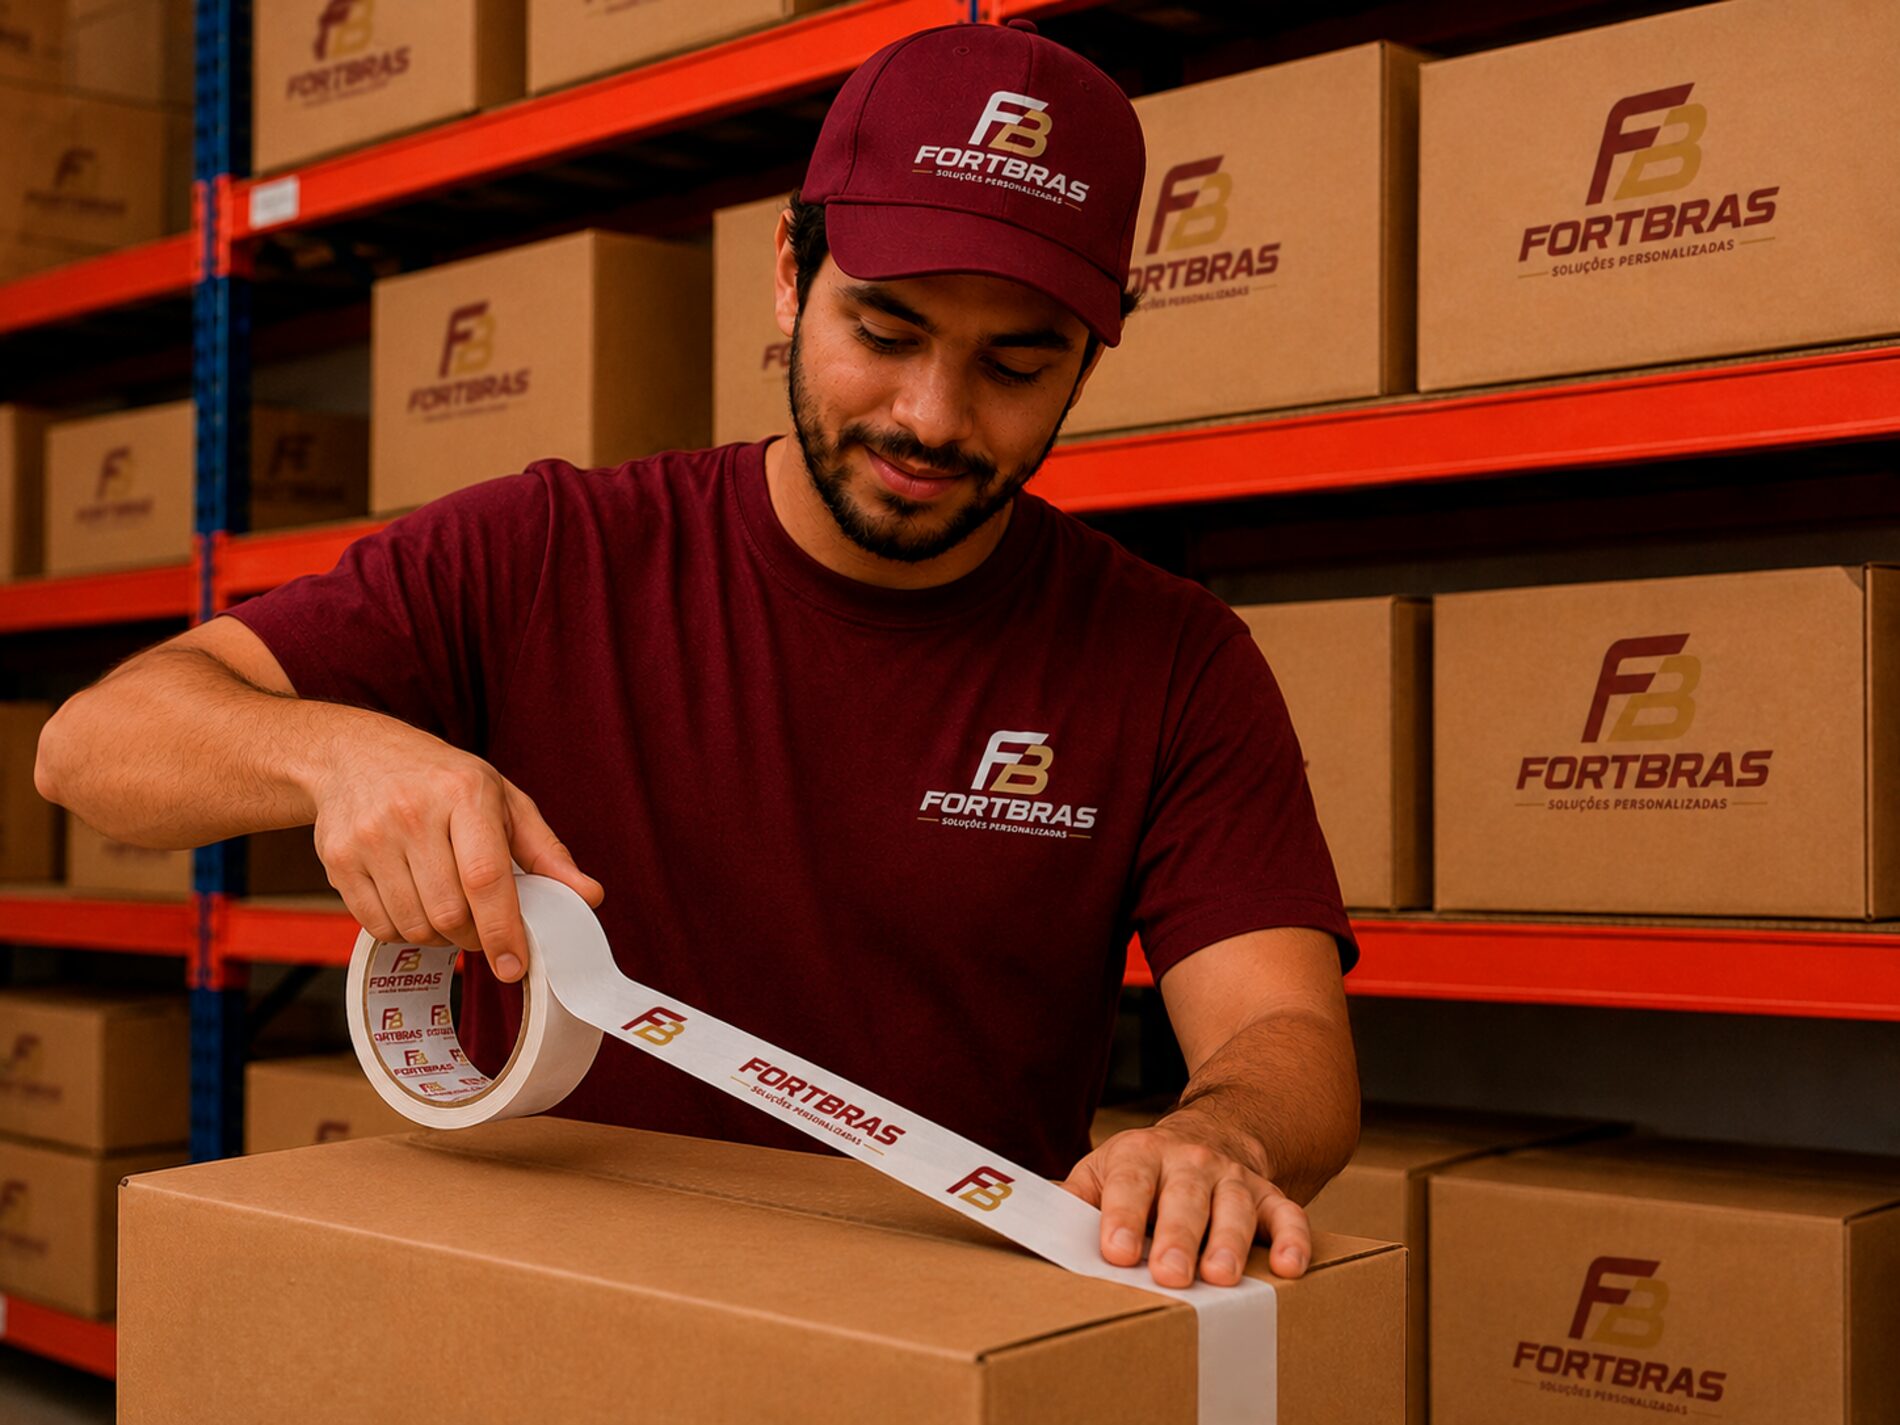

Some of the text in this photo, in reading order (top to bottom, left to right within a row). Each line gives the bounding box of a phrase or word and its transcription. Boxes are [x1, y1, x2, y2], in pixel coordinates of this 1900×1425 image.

[968, 91, 1053, 158] FB
[1585, 82, 1708, 206] FB
[914, 145, 1090, 203] FORTBRAS
[936, 169, 1063, 205] SOLUÇÕES PERSONALIZADAS
[1145, 154, 1233, 256] FB
[1518, 186, 1780, 262] FORTBRAS
[1126, 242, 1281, 295] ORTBRAS
[1552, 239, 1735, 277] SOLUÇÕES PERSONALIZADAS
[438, 300, 497, 380] FB
[407, 366, 531, 414] FORTBRAS
[1581, 633, 1702, 743] FB
[971, 730, 1054, 795] FB
[1516, 750, 1774, 790] FORTBRAS
[919, 790, 1098, 829] FORTBRAS
[942, 817, 1068, 839] SOLUÇÕES PERSONALIZADAS
[1548, 796, 1728, 813] SOLUÇÕES PERSONALIZADAS
[369, 972, 443, 988] FORTBRAS
[391, 948, 422, 973] FB
[620, 1006, 688, 1046] FB
[738, 1057, 906, 1146] FORTBRAS
[945, 1165, 1015, 1212] FB
[1568, 1256, 1671, 1349] FB
[1512, 1341, 1727, 1402] FORTBRAS
[1539, 1380, 1688, 1416] SOLUÇÕES PERSONALIZADAS
